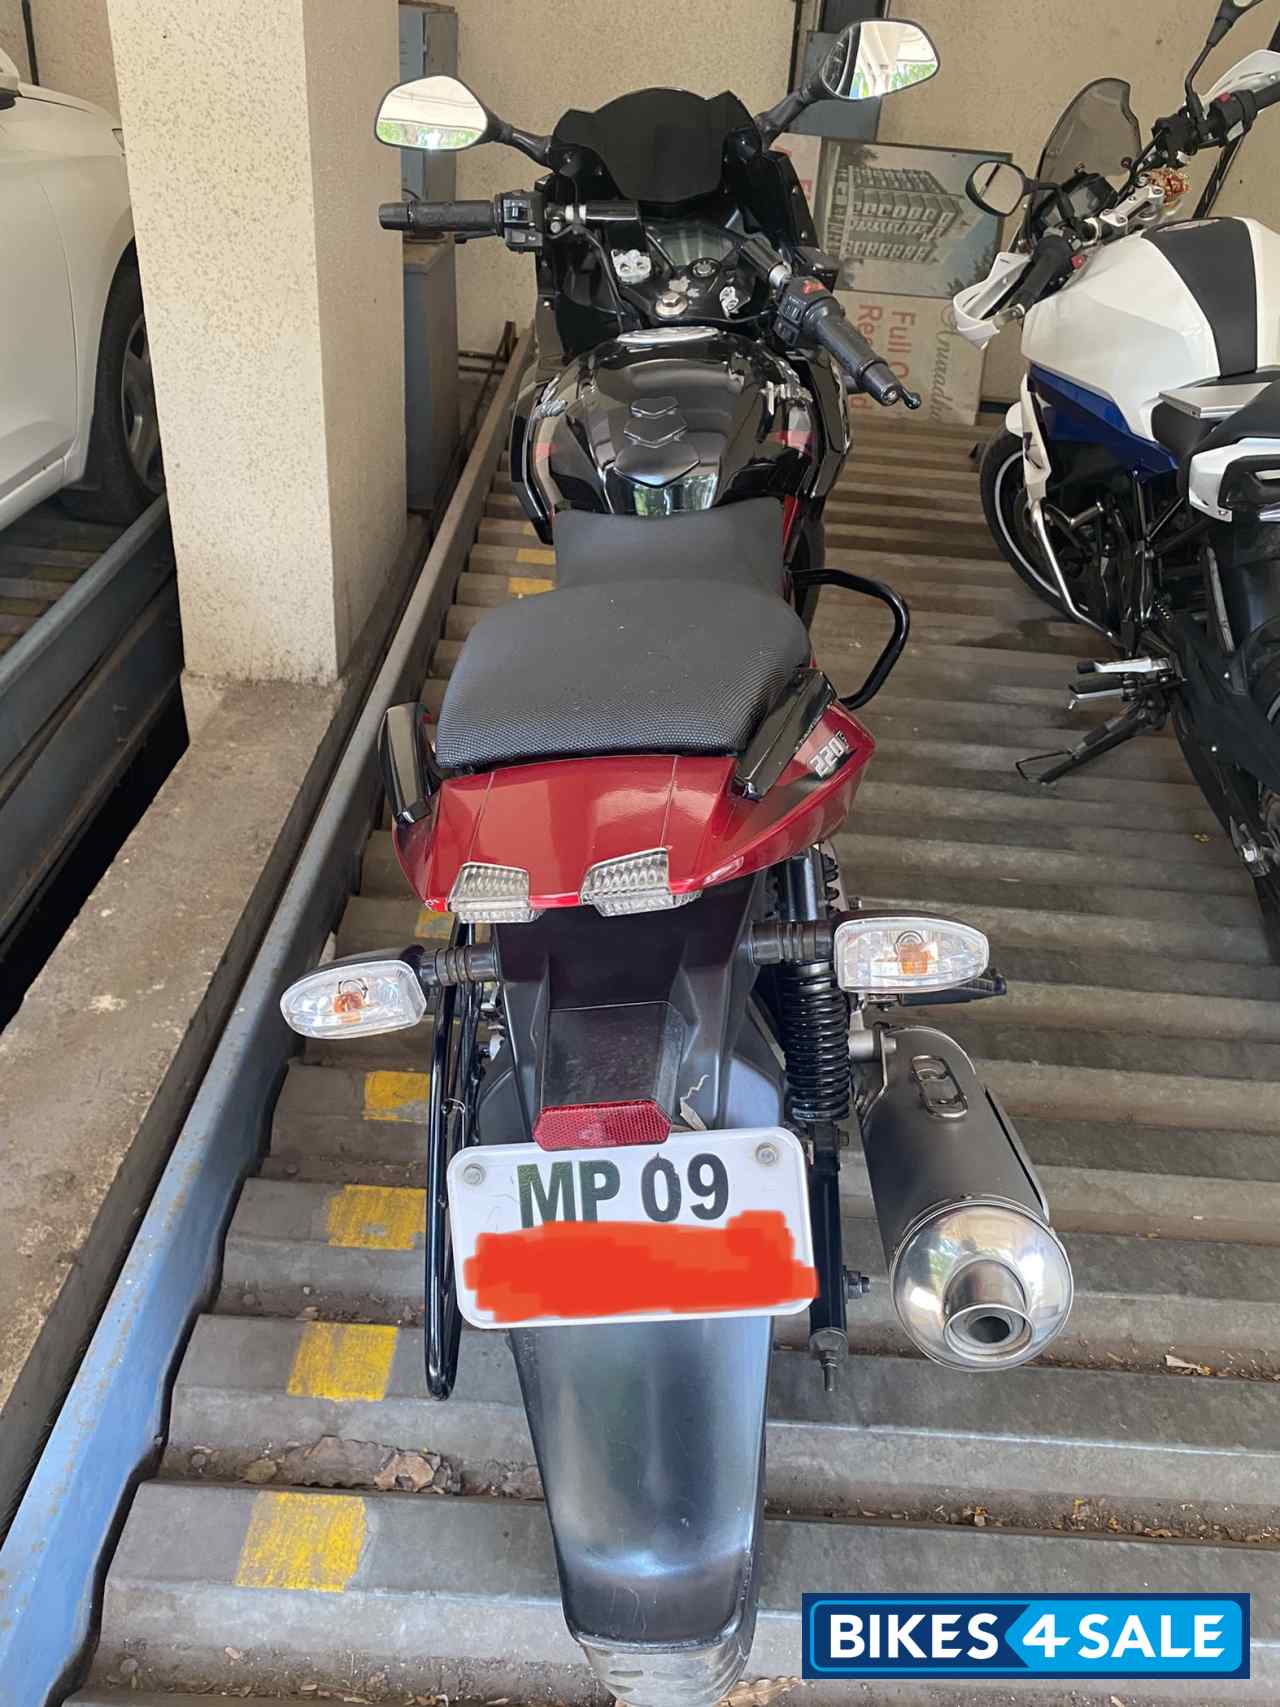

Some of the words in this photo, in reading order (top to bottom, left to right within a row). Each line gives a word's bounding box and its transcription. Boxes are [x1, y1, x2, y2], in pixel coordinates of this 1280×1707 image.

[888, 311, 914, 353] Full
[516, 1160, 621, 1228] MP
[641, 1152, 729, 1222] 09
